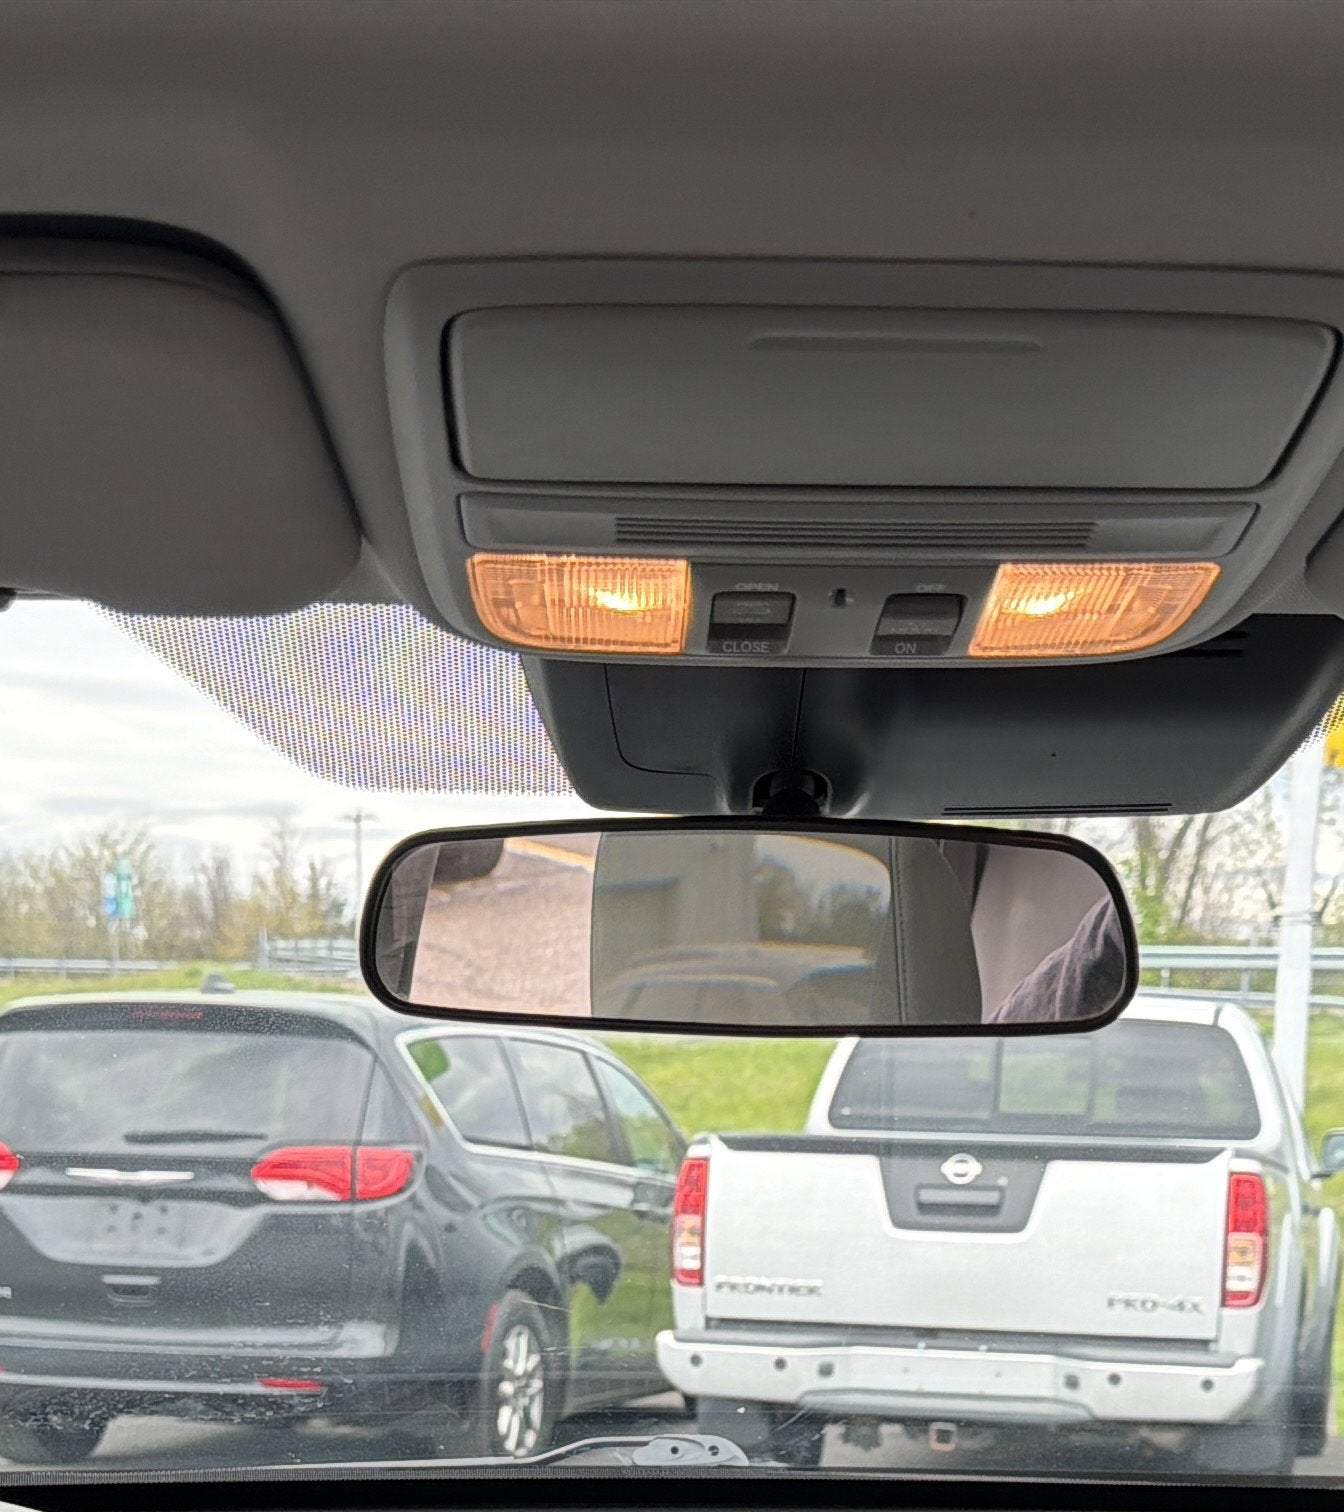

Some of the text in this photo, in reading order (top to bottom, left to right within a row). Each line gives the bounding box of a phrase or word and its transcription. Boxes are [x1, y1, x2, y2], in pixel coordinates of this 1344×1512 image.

[735, 583, 780, 592] OPEN
[915, 583, 948, 592] OFF
[722, 640, 771, 654] CLOSE
[894, 642, 918, 655] ON
